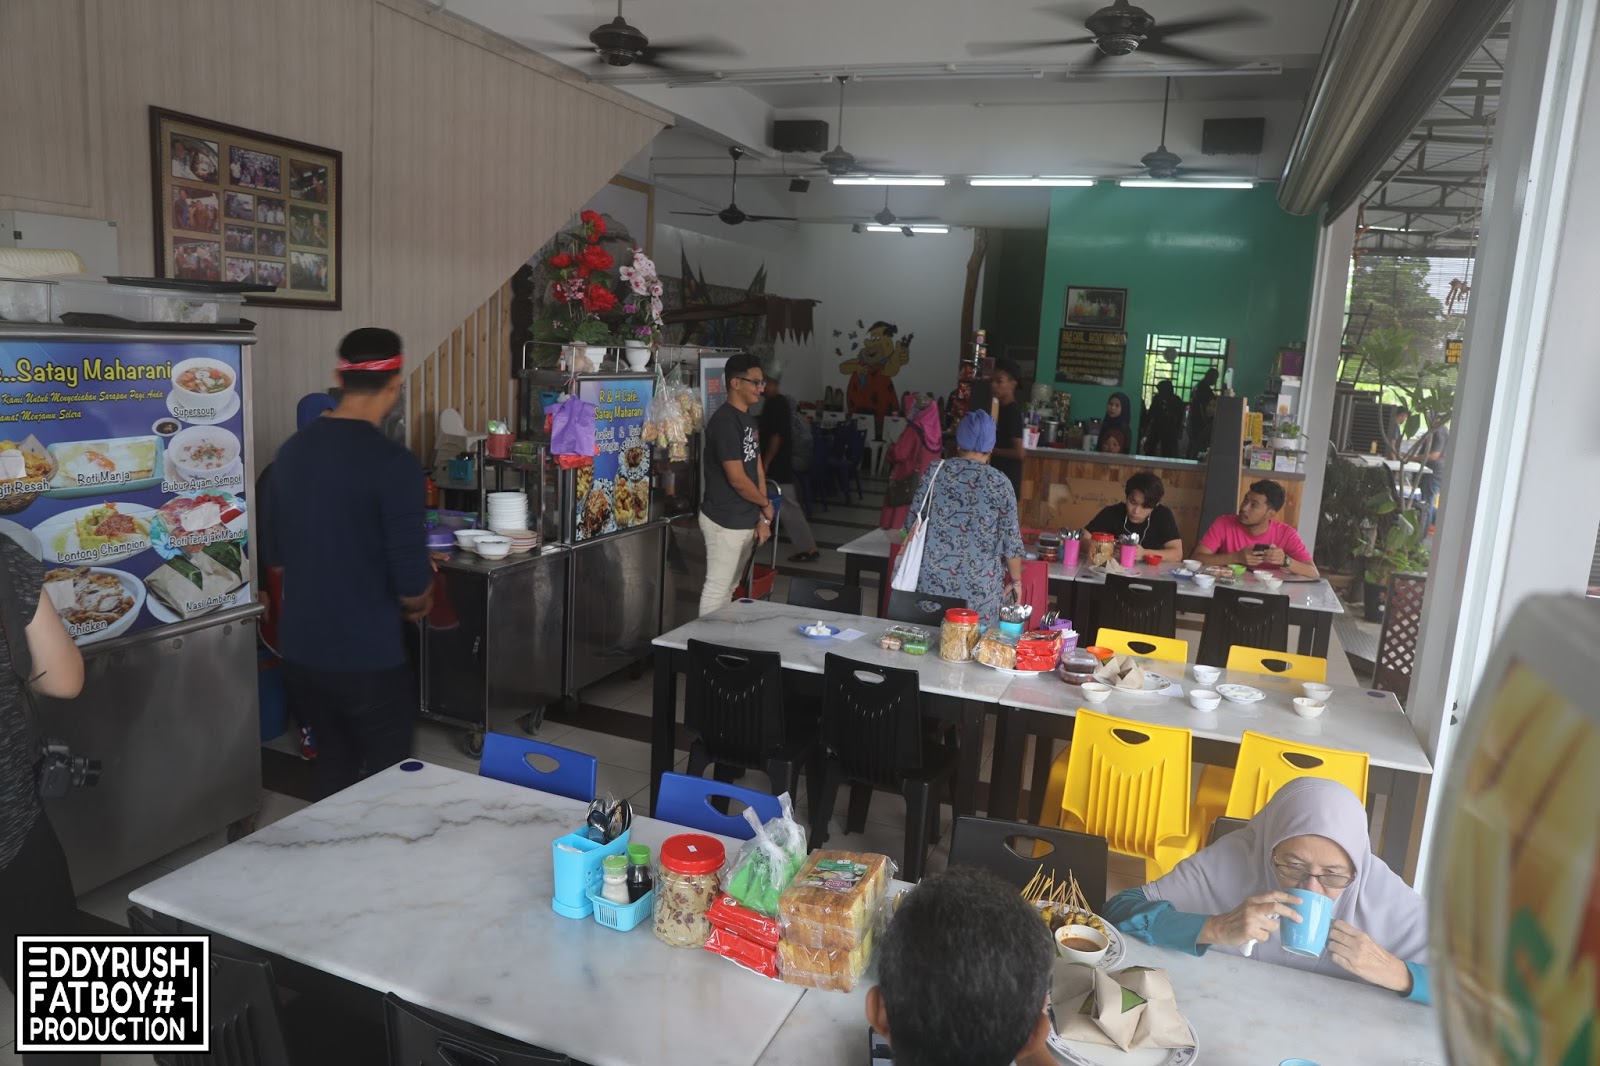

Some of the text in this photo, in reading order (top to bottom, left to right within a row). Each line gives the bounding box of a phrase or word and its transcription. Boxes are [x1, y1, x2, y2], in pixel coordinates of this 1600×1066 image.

[83, 358, 172, 381] Maharani
[26, 392, 49, 403] Untuk
[50, 392, 97, 404] Menyediakan
[99, 391, 128, 402] Sarapan
[21, 410, 57, 423] Menjamu
[59, 409, 82, 420] Selera
[173, 406, 216, 420] Supersoup
[77, 470, 131, 485] Roti Manja
[162, 474, 242, 493] Bubur Ayam Sempoi
[14, 479, 50, 494] Resah
[169, 536, 187, 547] Roti
[221, 528, 245, 539] Mandi
[57, 540, 145, 563] Lontong Champion
[186, 594, 236, 611] Nasi Ambeng
[69, 620, 108, 635] Chicken
